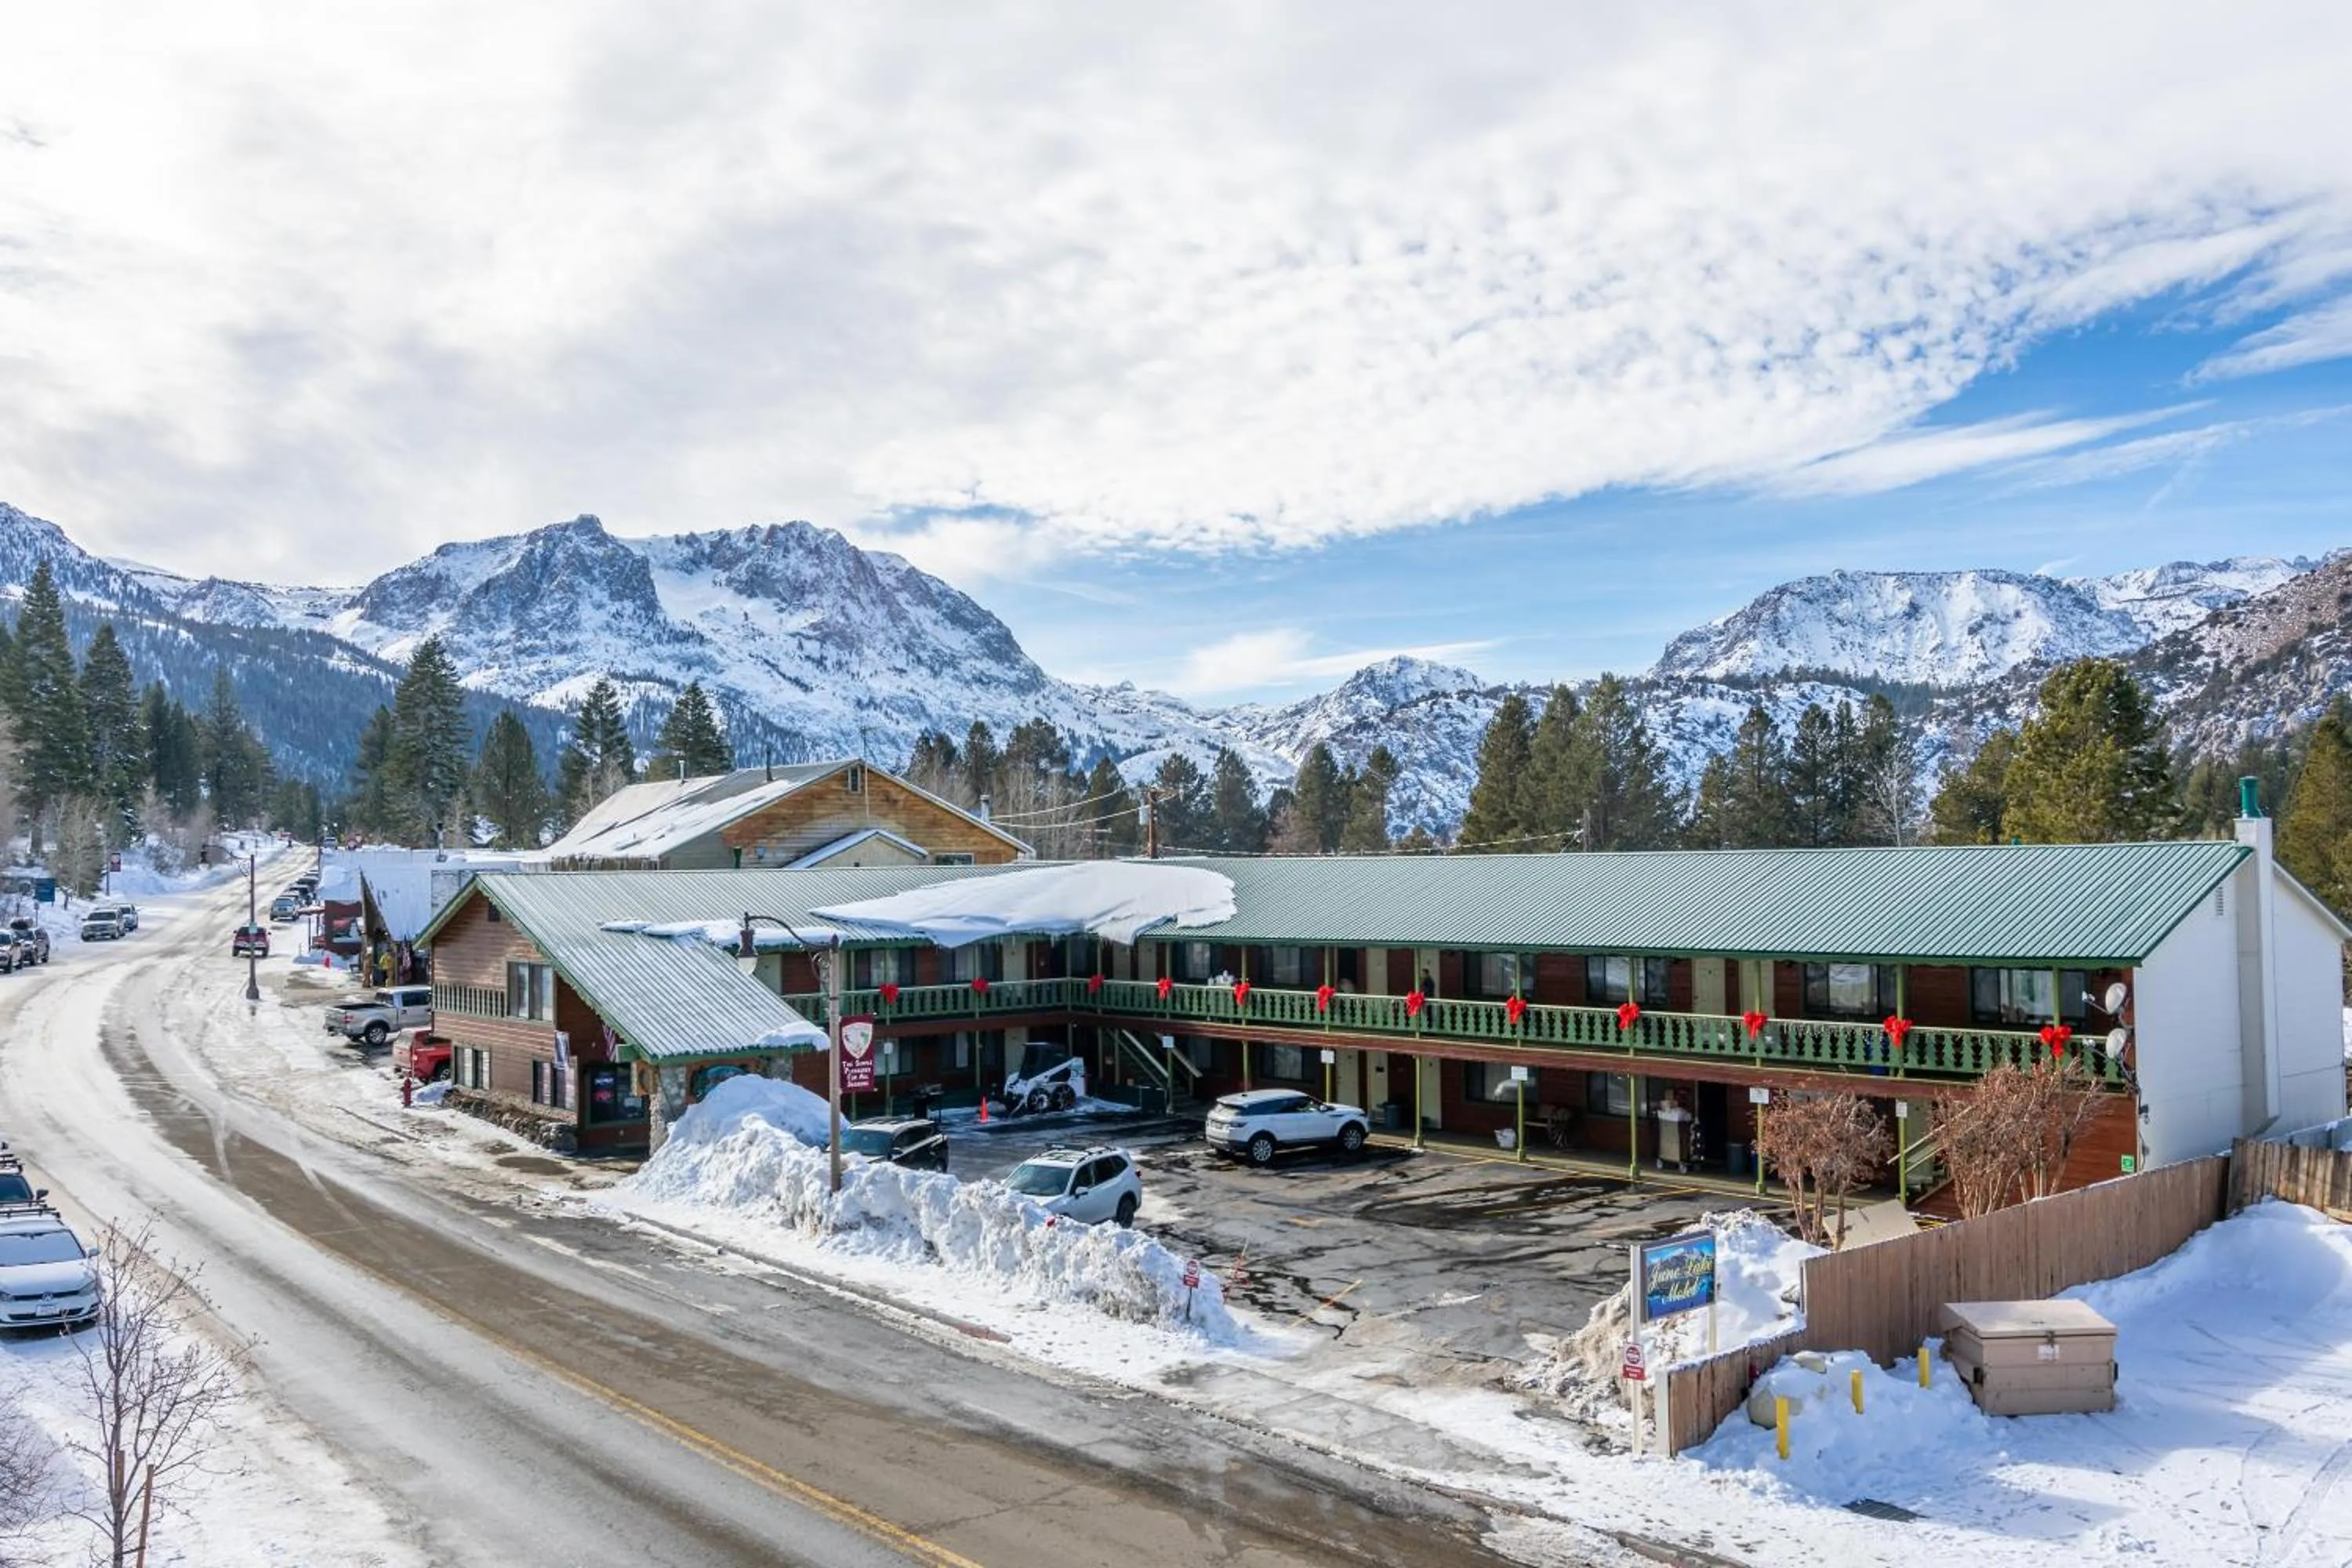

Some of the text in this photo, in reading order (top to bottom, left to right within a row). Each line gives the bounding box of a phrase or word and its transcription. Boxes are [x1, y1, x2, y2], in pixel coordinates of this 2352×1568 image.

[1648, 1254, 1713, 1292] June Lake
[1668, 1276, 1700, 1299] Motel
